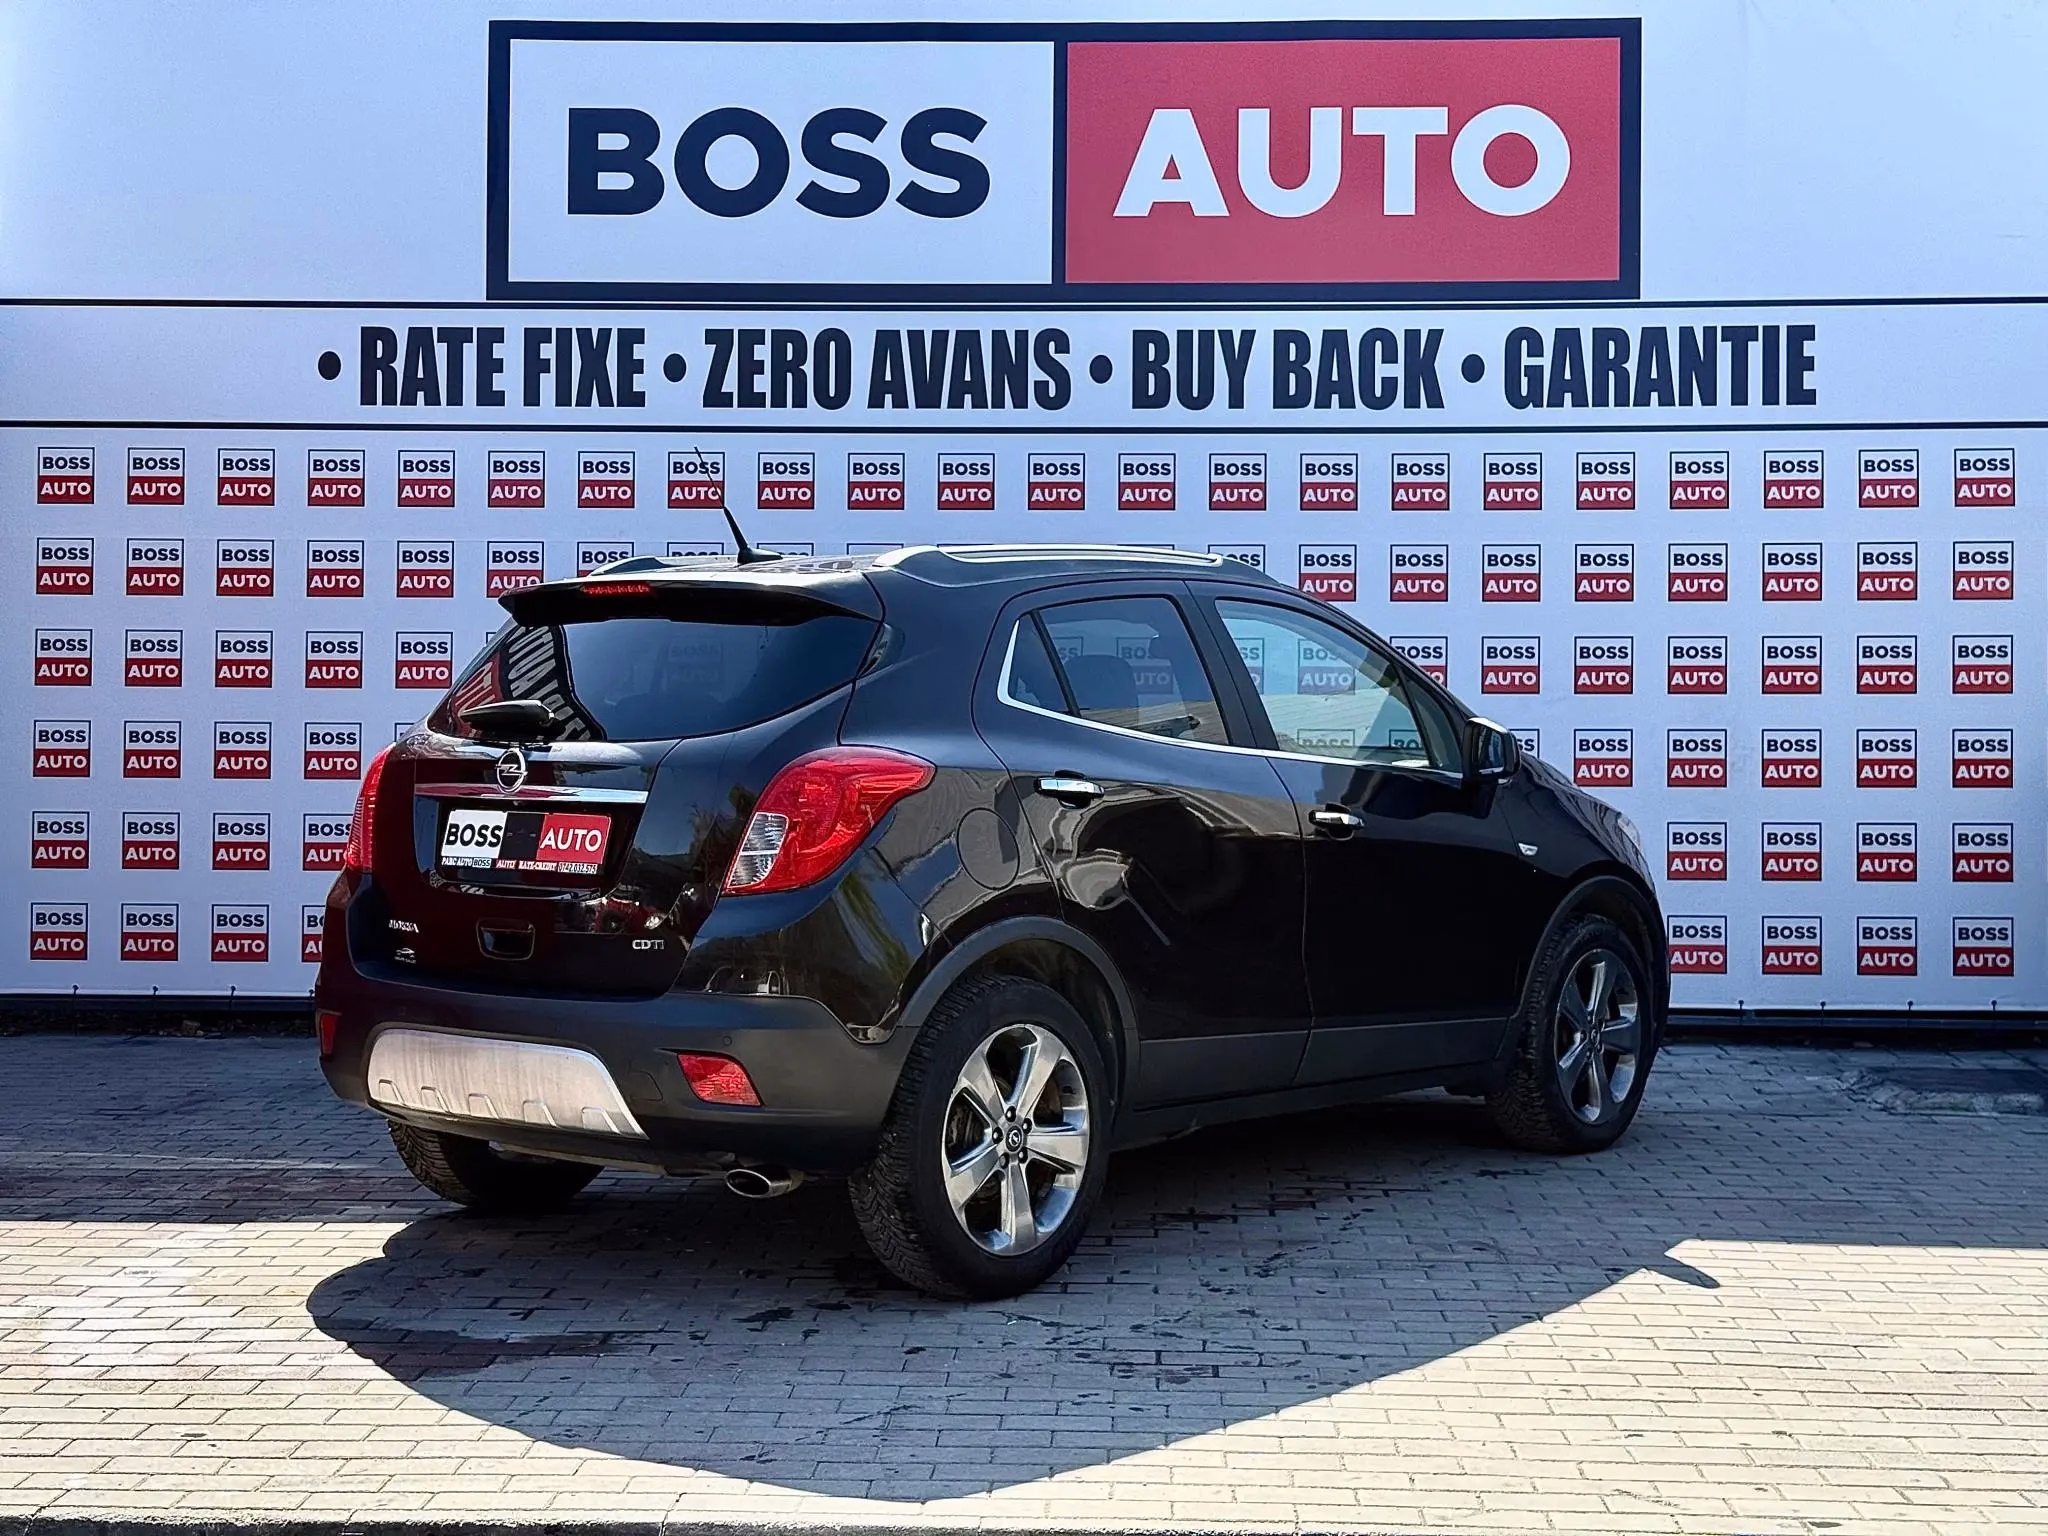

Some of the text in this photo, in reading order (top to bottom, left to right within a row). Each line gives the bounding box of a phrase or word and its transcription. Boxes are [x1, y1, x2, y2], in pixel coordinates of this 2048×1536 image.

[568, 105, 1570, 218] BOSS AUTO
[361, 325, 1816, 410] RATE FIXE ZERO AVANS BUY BACK GARANTIE
[42, 456, 90, 470] BOSS
[132, 457, 180, 470] BOSS
[223, 458, 271, 471] BOSS
[313, 459, 360, 472] BOSS
[403, 459, 450, 473] BOSS
[493, 460, 541, 473] BOSS
[583, 461, 631, 474] BOSS
[763, 462, 810, 475] BOSS
[853, 462, 900, 475] BOSS
[943, 462, 990, 476] BOSS
[1123, 463, 1171, 476] BOSS
[1214, 463, 1262, 476] BOSS
[1305, 463, 1353, 476] BOSS
[1489, 462, 1537, 475] BOSS
[1581, 461, 1630, 475] BOSS
[1675, 461, 1724, 474] BOSS
[1769, 460, 1819, 473] BOSS
[1864, 459, 1914, 472] BOSS
[1960, 458, 2010, 472] BOSS
[41, 482, 91, 495] AUTO
[130, 483, 181, 496] AUTO
[221, 484, 271, 496] AUTO
[311, 485, 361, 497] AUTO
[401, 485, 451, 498] AUTO
[491, 486, 541, 499] AUTO
[581, 486, 631, 499] AUTO
[761, 487, 811, 500] AUTO
[851, 488, 901, 501] AUTO
[941, 488, 991, 501] AUTO
[1121, 488, 1173, 501] AUTO
[1303, 488, 1355, 502] AUTO
[1487, 488, 1539, 502] AUTO
[1579, 487, 1632, 501] AUTO
[1673, 487, 1726, 500] AUTO
[1767, 486, 1820, 500] AUTO
[1862, 485, 1916, 499] AUTO
[1958, 484, 2012, 498] AUTO
[1212, 489, 1263, 502] AUTO
[41, 547, 89, 560] BOSS
[132, 548, 179, 561] BOSS
[222, 548, 270, 562] BOSS
[312, 549, 360, 563] BOSS
[402, 550, 450, 563] BOSS
[492, 550, 540, 564] BOSS
[1304, 553, 1352, 567] BOSS
[1395, 553, 1444, 567] BOSS
[1487, 553, 1536, 567] BOSS
[1580, 553, 1629, 567] BOSS
[1673, 553, 1723, 566] BOSS
[1768, 552, 1818, 566] BOSS
[1862, 552, 1913, 565] BOSS
[1958, 551, 2009, 564] BOSS
[40, 573, 89, 585] AUTO
[130, 574, 180, 586] AUTO
[220, 574, 270, 587] AUTO
[310, 575, 360, 588] AUTO
[400, 576, 450, 588] AUTO
[1671, 579, 1724, 592] AUTO
[1766, 578, 1819, 592] AUTO
[1860, 578, 1914, 591] AUTO
[1956, 577, 2011, 591] AUTO
[1393, 579, 1445, 593] AUTO
[1485, 579, 1537, 593] AUTO
[1578, 579, 1630, 593] AUTO
[40, 638, 88, 652] BOSS
[130, 639, 178, 652] BOSS
[220, 640, 268, 653] BOSS
[310, 641, 358, 654] BOSS
[401, 641, 448, 654] BOSS
[1958, 645, 2008, 658] BOSS
[1487, 646, 1535, 659] BOSS
[1579, 646, 1629, 659] BOSS
[1673, 646, 1722, 659] BOSS
[1767, 645, 1817, 659] BOSS
[1862, 645, 1912, 659] BOSS
[38, 664, 88, 677] AUTO
[128, 665, 178, 678] AUTO
[218, 666, 269, 678] AUTO
[309, 666, 359, 679] AUTO
[399, 667, 449, 680] AUTO
[1485, 672, 1536, 685] AUTO
[1577, 672, 1629, 685] AUTO
[1671, 672, 1724, 685] AUTO
[1765, 672, 1818, 685] AUTO
[1860, 671, 1913, 685] AUTO
[1956, 671, 2010, 685] AUTO
[38, 729, 86, 743] BOSS
[128, 730, 177, 744] BOSS
[219, 731, 267, 745] BOSS
[309, 732, 357, 745] BOSS
[1579, 738, 1628, 752] BOSS
[1672, 739, 1722, 752] BOSS
[1767, 739, 1817, 752] BOSS
[1862, 739, 1912, 752] BOSS
[1958, 739, 2008, 753] BOSS
[37, 755, 87, 768] AUTO
[127, 756, 177, 769] AUTO
[217, 757, 267, 770] AUTO
[307, 758, 357, 770] AUTO
[1577, 765, 1629, 778] AUTO
[1671, 765, 1723, 778] AUTO
[1765, 765, 1818, 778] AUTO
[1860, 765, 1913, 778] AUTO
[1956, 765, 2009, 778] AUTO
[37, 820, 85, 835] BOSS
[127, 821, 175, 835] BOSS
[217, 822, 266, 836] BOSS
[445, 823, 603, 852] BOSS AUTO
[1672, 832, 1722, 846] BOSS
[1767, 832, 1817, 846] BOSS
[1862, 832, 1912, 846] BOSS
[1958, 832, 2009, 847] BOSS
[35, 847, 85, 859] AUTO
[126, 848, 176, 860] AUTO
[216, 848, 266, 861] AUTO
[473, 858, 491, 867] BOSS
[1671, 858, 1723, 871] AUTO
[1765, 859, 1818, 872] AUTO
[1860, 859, 1913, 872] AUTO
[1956, 859, 2009, 872] AUTO
[35, 912, 84, 926] BOSS
[126, 913, 174, 927] BOSS
[216, 913, 265, 927] BOSS
[1672, 925, 1723, 939] BOSS
[1767, 925, 1818, 940] BOSS
[1862, 926, 1913, 941] BOSS
[1958, 926, 2009, 940] BOSS
[34, 938, 84, 951] AUTO
[124, 939, 174, 951] AUTO
[215, 940, 265, 952] AUTO
[1671, 951, 1723, 965] AUTO
[1766, 952, 1818, 965] AUTO
[1861, 953, 1913, 966] AUTO
[1957, 954, 2010, 967] AUTO
